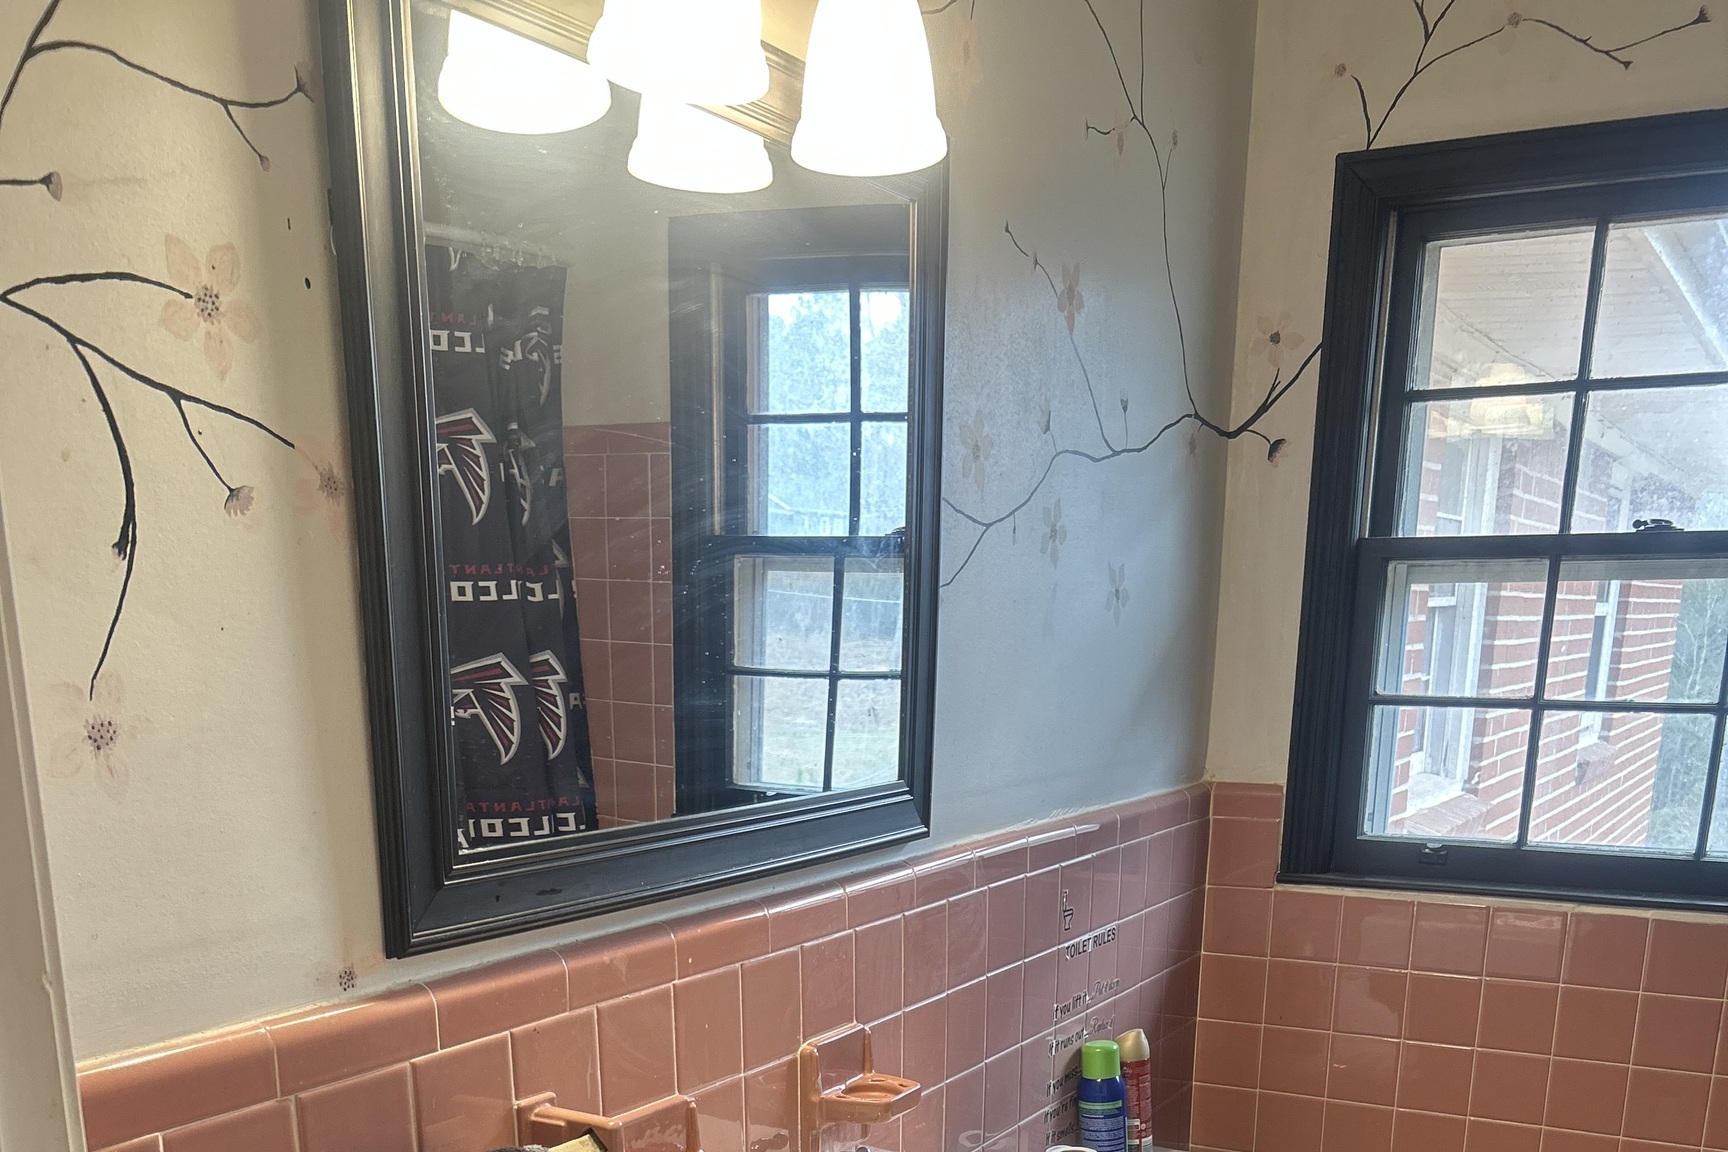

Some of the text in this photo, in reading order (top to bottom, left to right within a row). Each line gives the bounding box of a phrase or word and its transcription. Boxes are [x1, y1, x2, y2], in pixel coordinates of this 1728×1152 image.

[1065, 927, 1116, 959] TOILET RULES
[1059, 1003, 1071, 1019] you
[1071, 992, 1082, 1010] lift
[1060, 1034, 1074, 1050] runs
[1052, 1077, 1063, 1095] you
